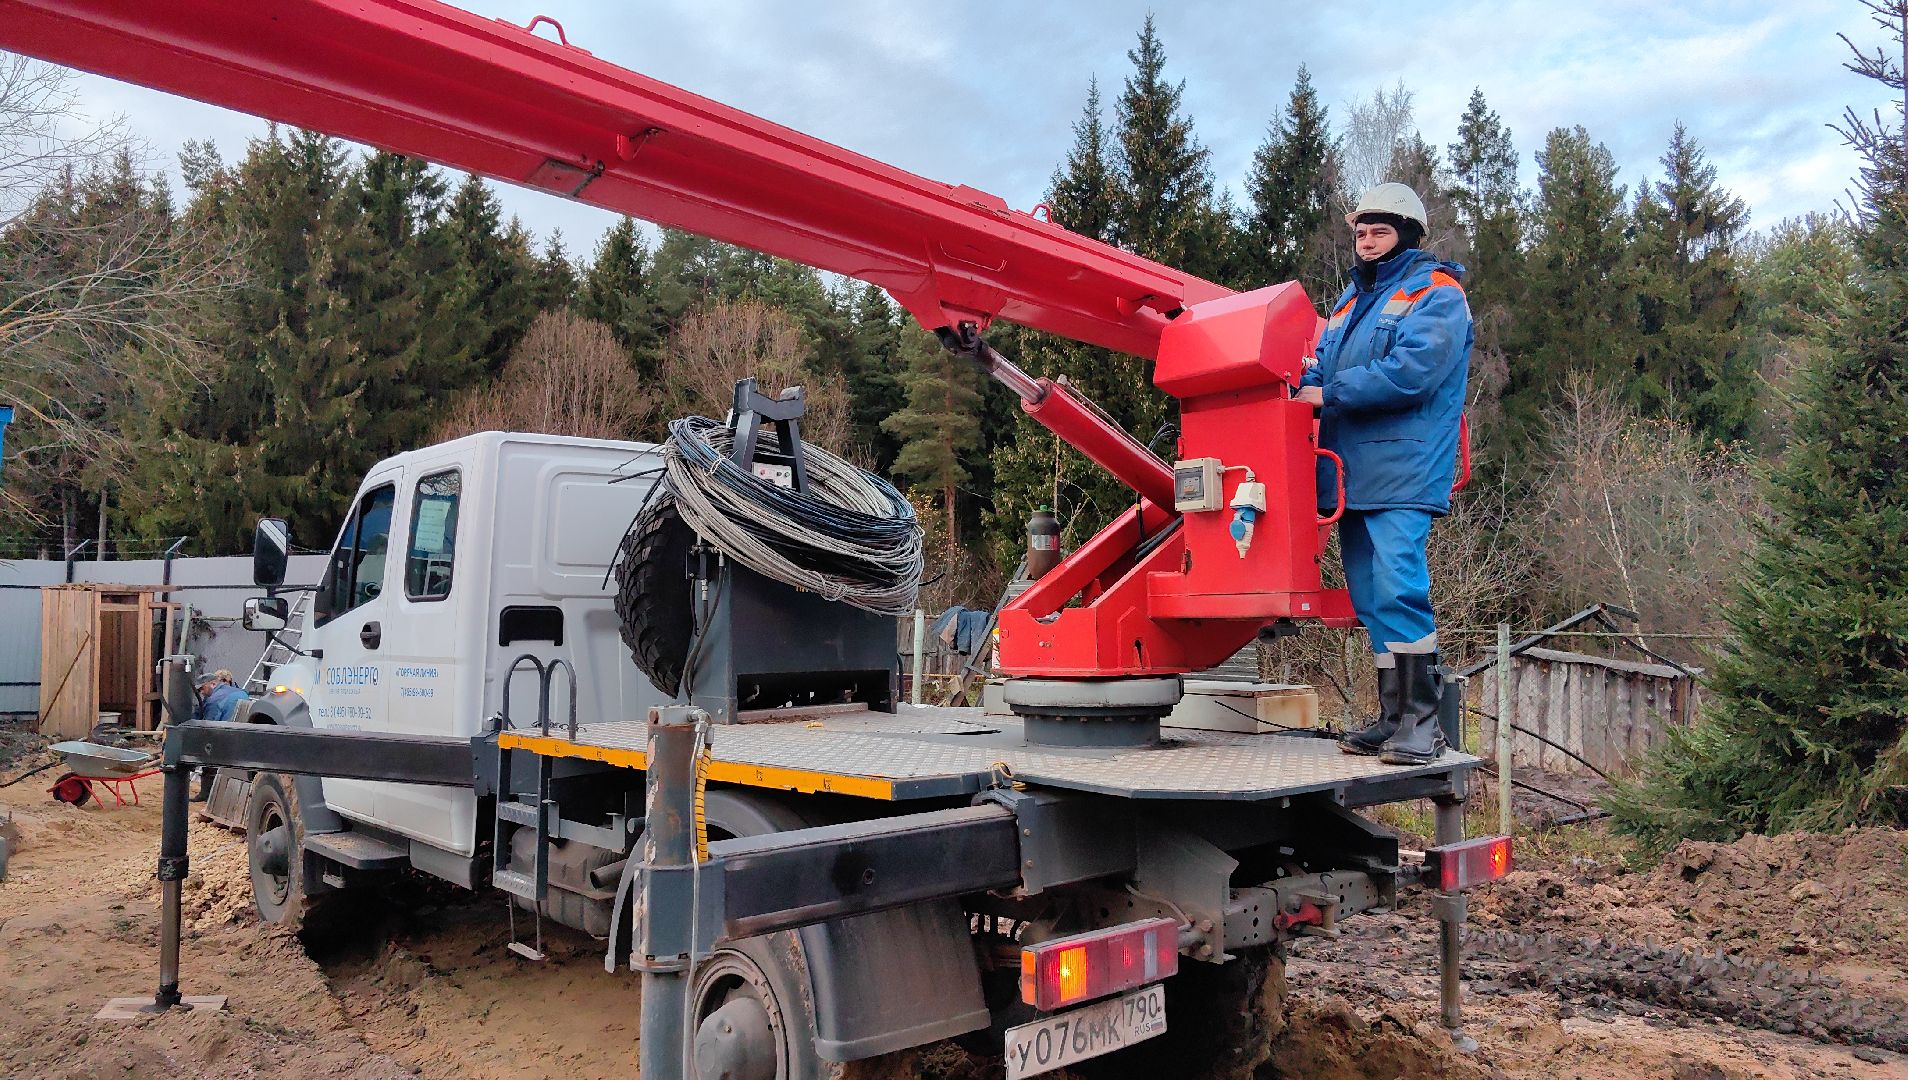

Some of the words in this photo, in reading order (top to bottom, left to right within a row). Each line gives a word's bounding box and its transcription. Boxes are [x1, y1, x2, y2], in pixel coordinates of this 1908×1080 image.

[1125, 992, 1158, 1027] 790
[1017, 1014, 1121, 1072] У076МК
[1134, 1022, 1151, 1037] RUS
